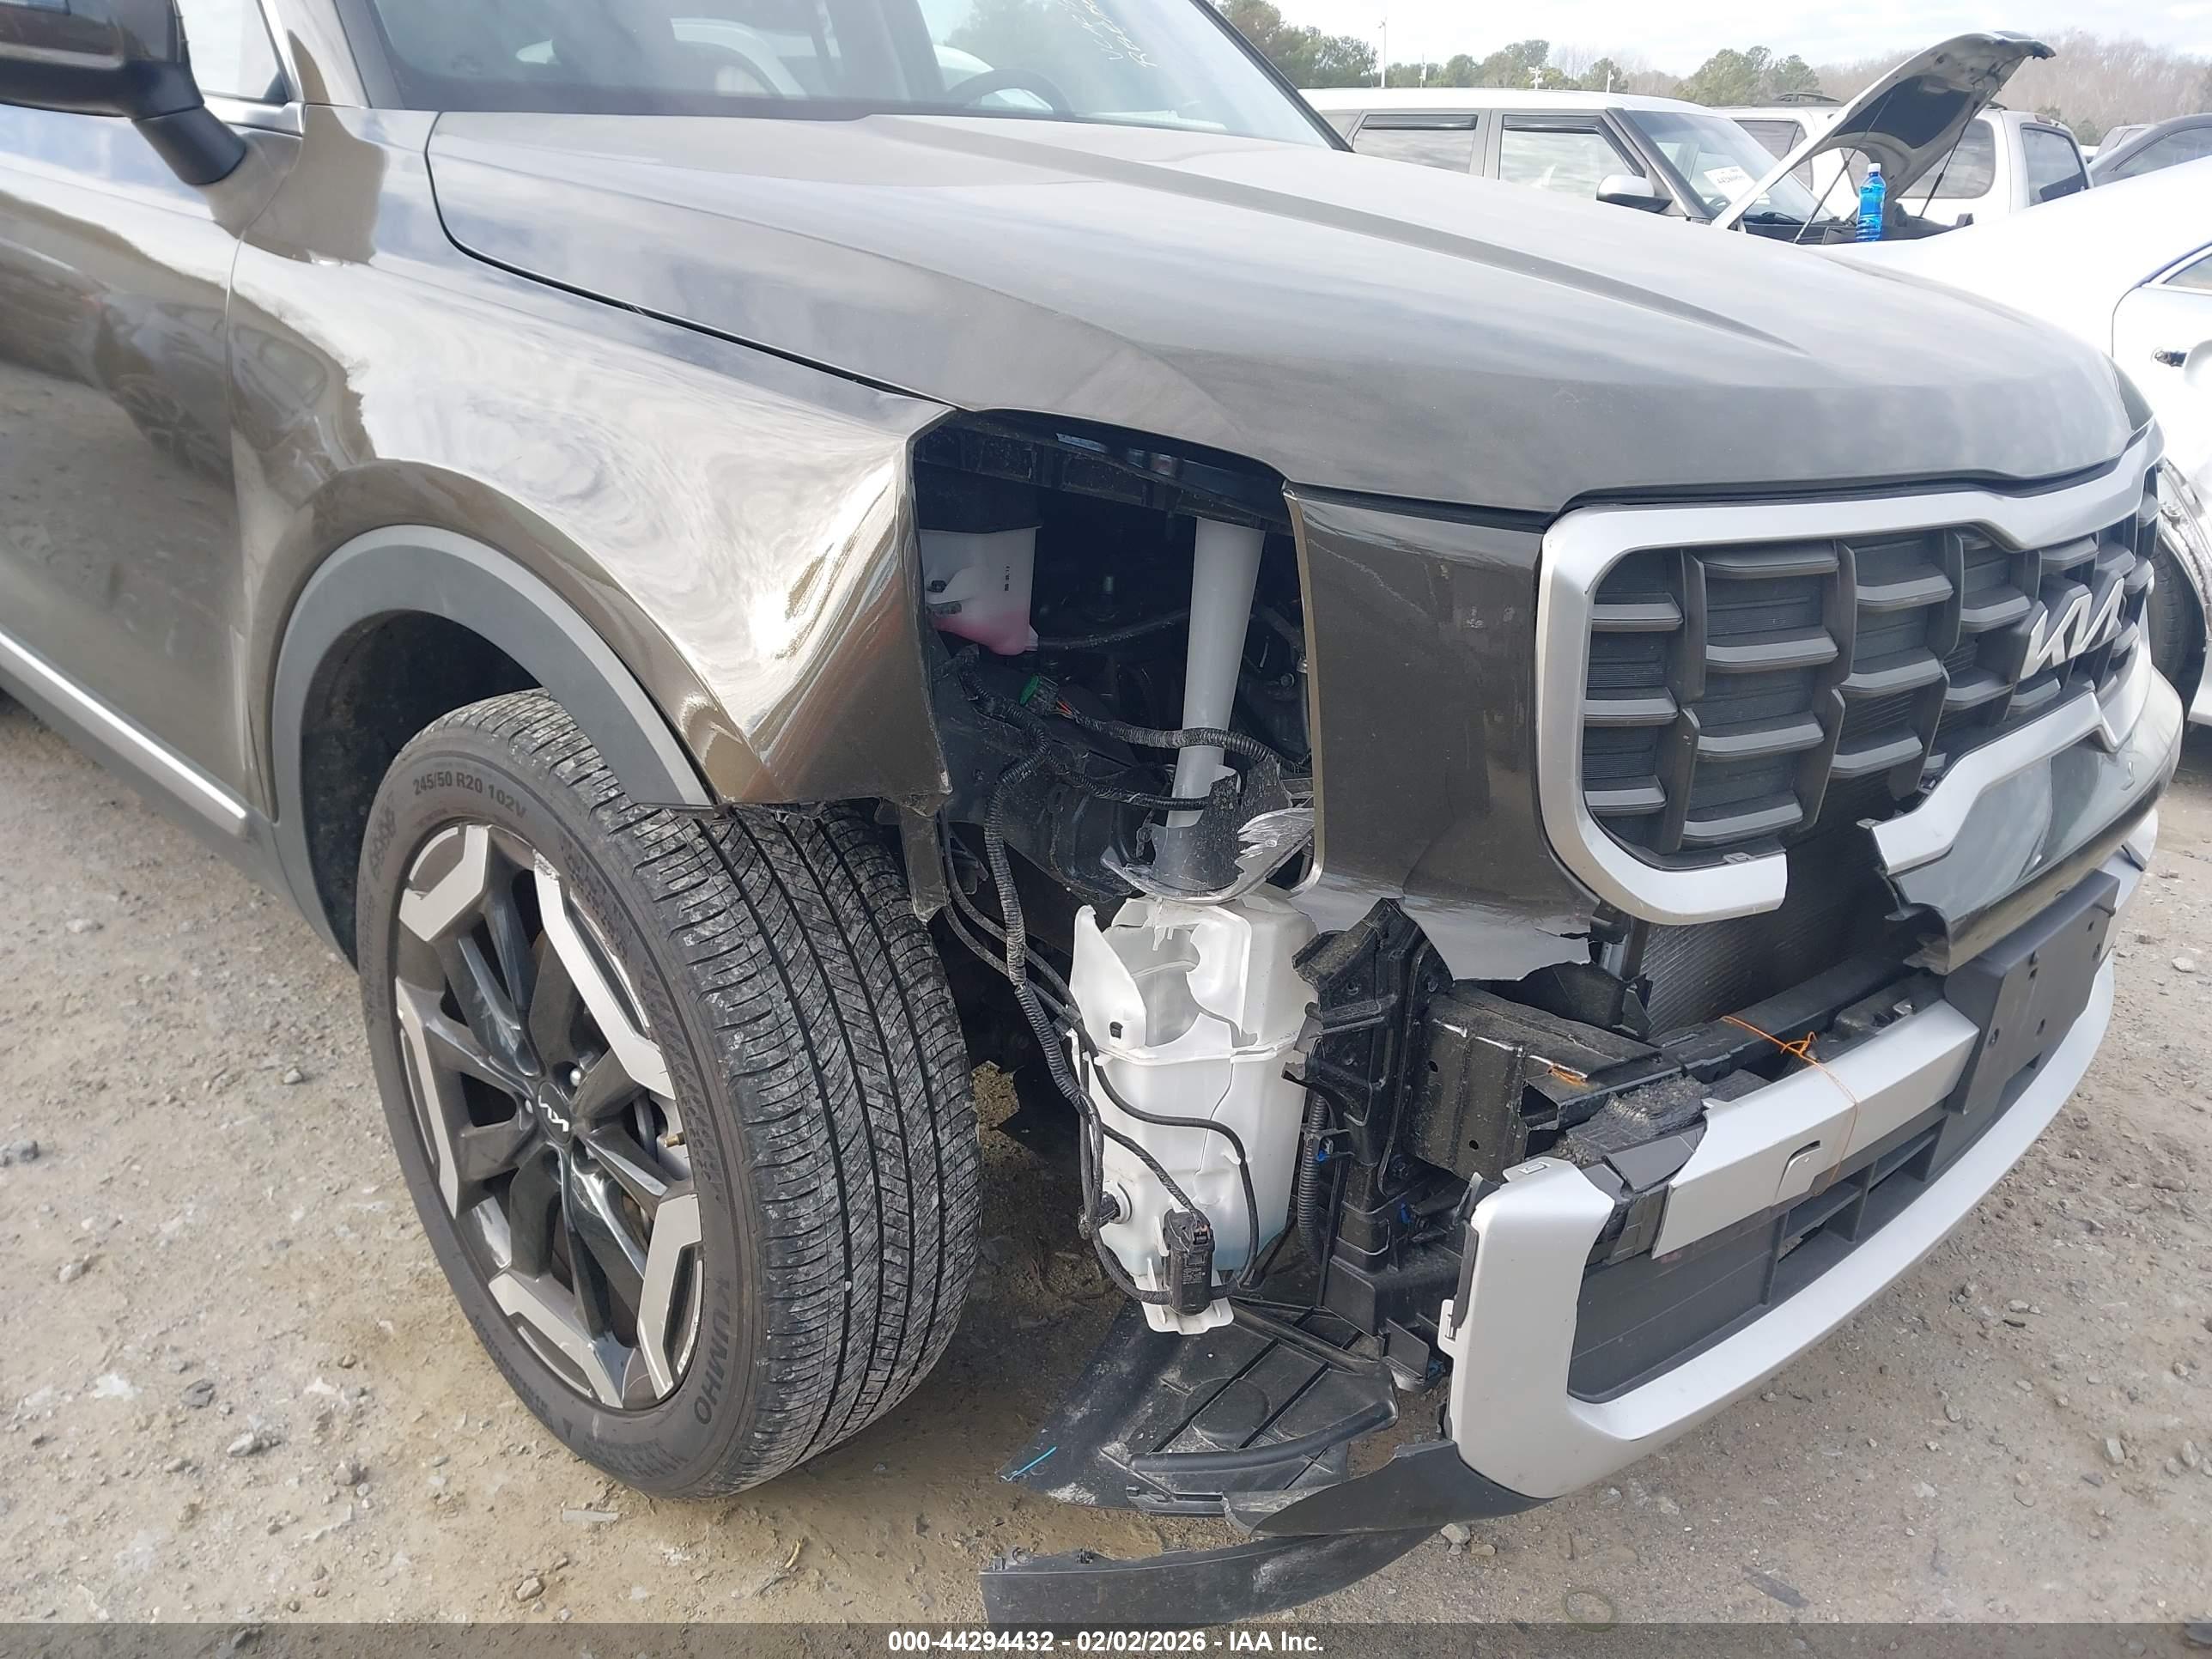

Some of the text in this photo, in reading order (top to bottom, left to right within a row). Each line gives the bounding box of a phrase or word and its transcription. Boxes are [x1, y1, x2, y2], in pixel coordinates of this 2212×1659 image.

[2020, 577, 2125, 680] KIA
[413, 771, 527, 818] 245/50 R20 102V
[693, 1274, 731, 1425] KUMHO
